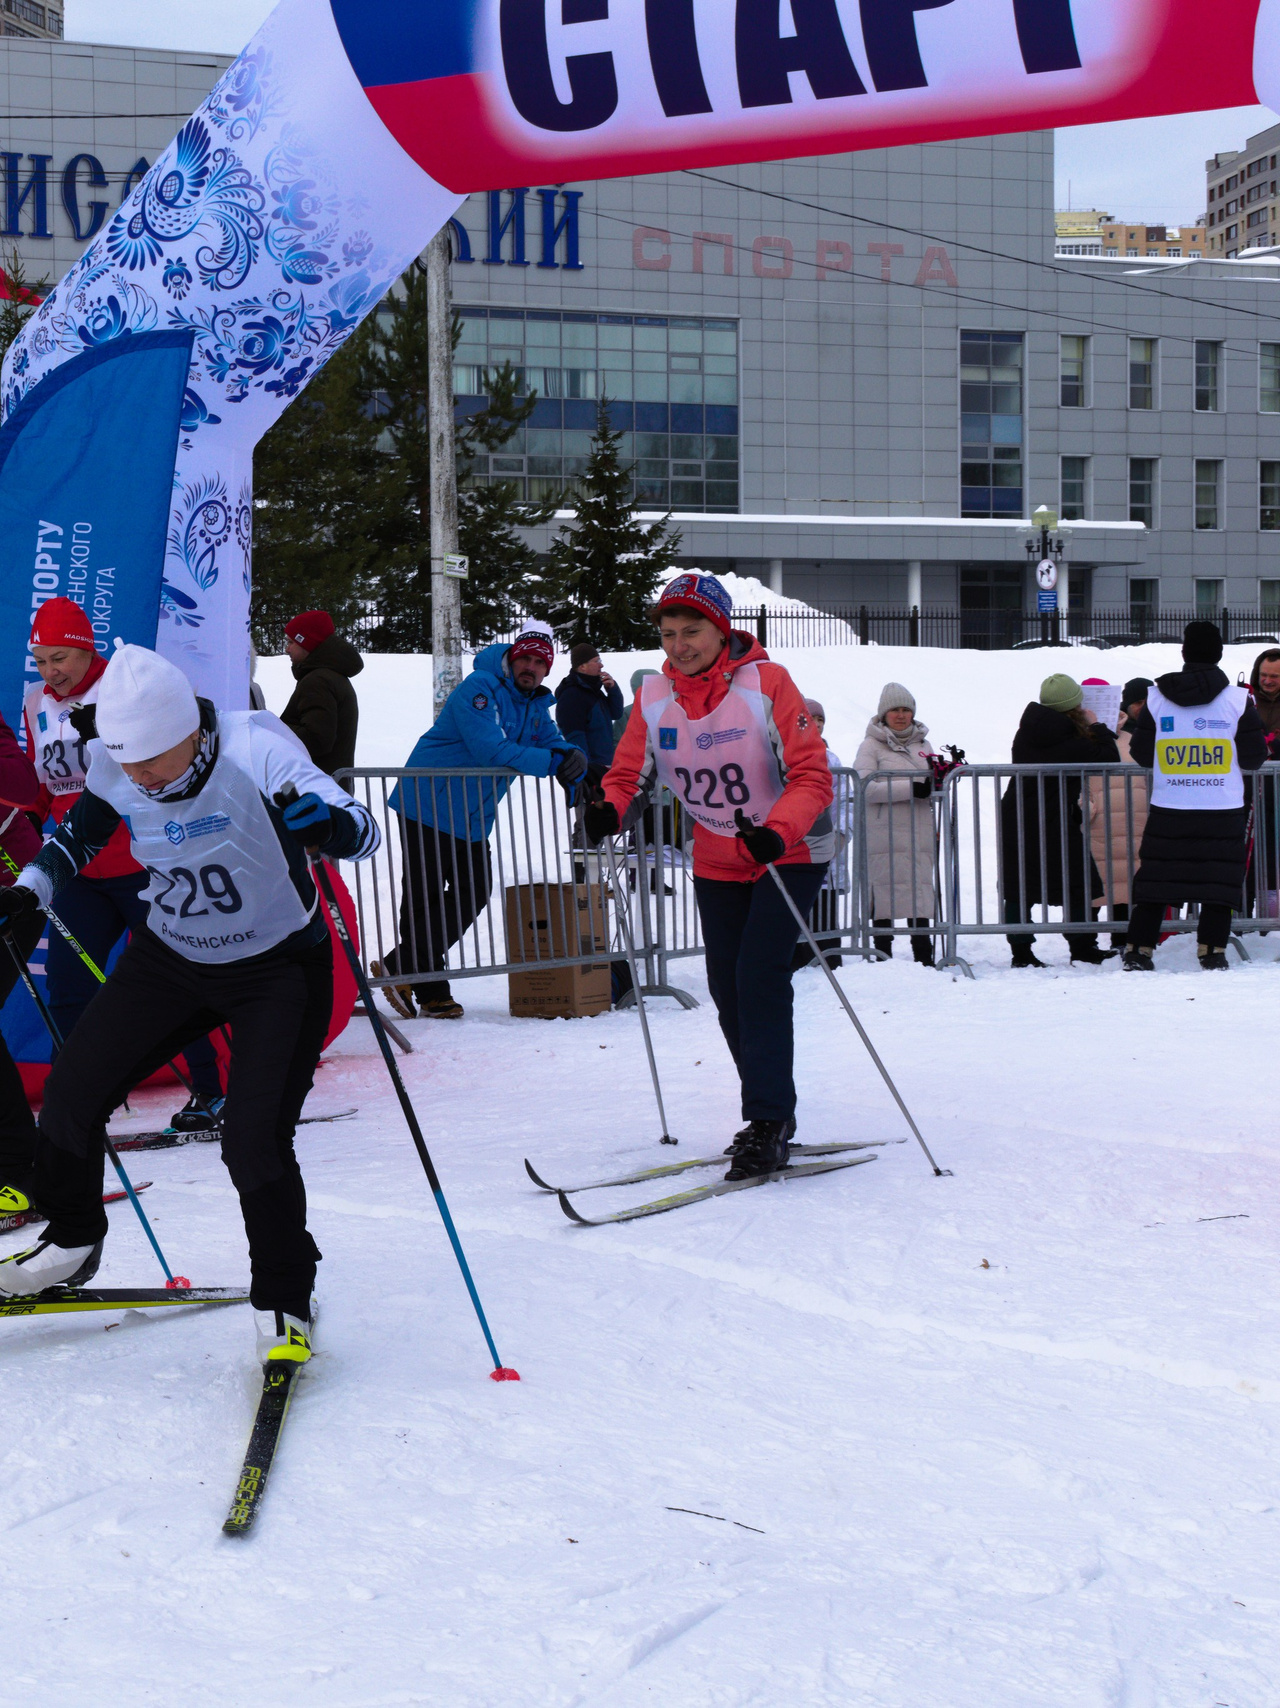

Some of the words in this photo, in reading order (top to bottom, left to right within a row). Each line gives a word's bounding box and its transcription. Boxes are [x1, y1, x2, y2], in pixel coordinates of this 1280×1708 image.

[631, 227, 959, 288] СПОРТА
[30, 520, 63, 626] ПОРТУ
[67, 522, 93, 609] ЕНСКОГО
[92, 567, 117, 635] ОКРУГА
[1165, 745, 1224, 767] СУДЬЯ
[1167, 779, 1225, 787] РАМЕНСКОЕ
[674, 763, 750, 808] 228
[690, 812, 762, 830] РАМЕНСЕ
[146, 863, 243, 919] 229
[161, 922, 258, 949] РАМЕНСКОЕ
[226, 1465, 261, 1525] FISCHER
